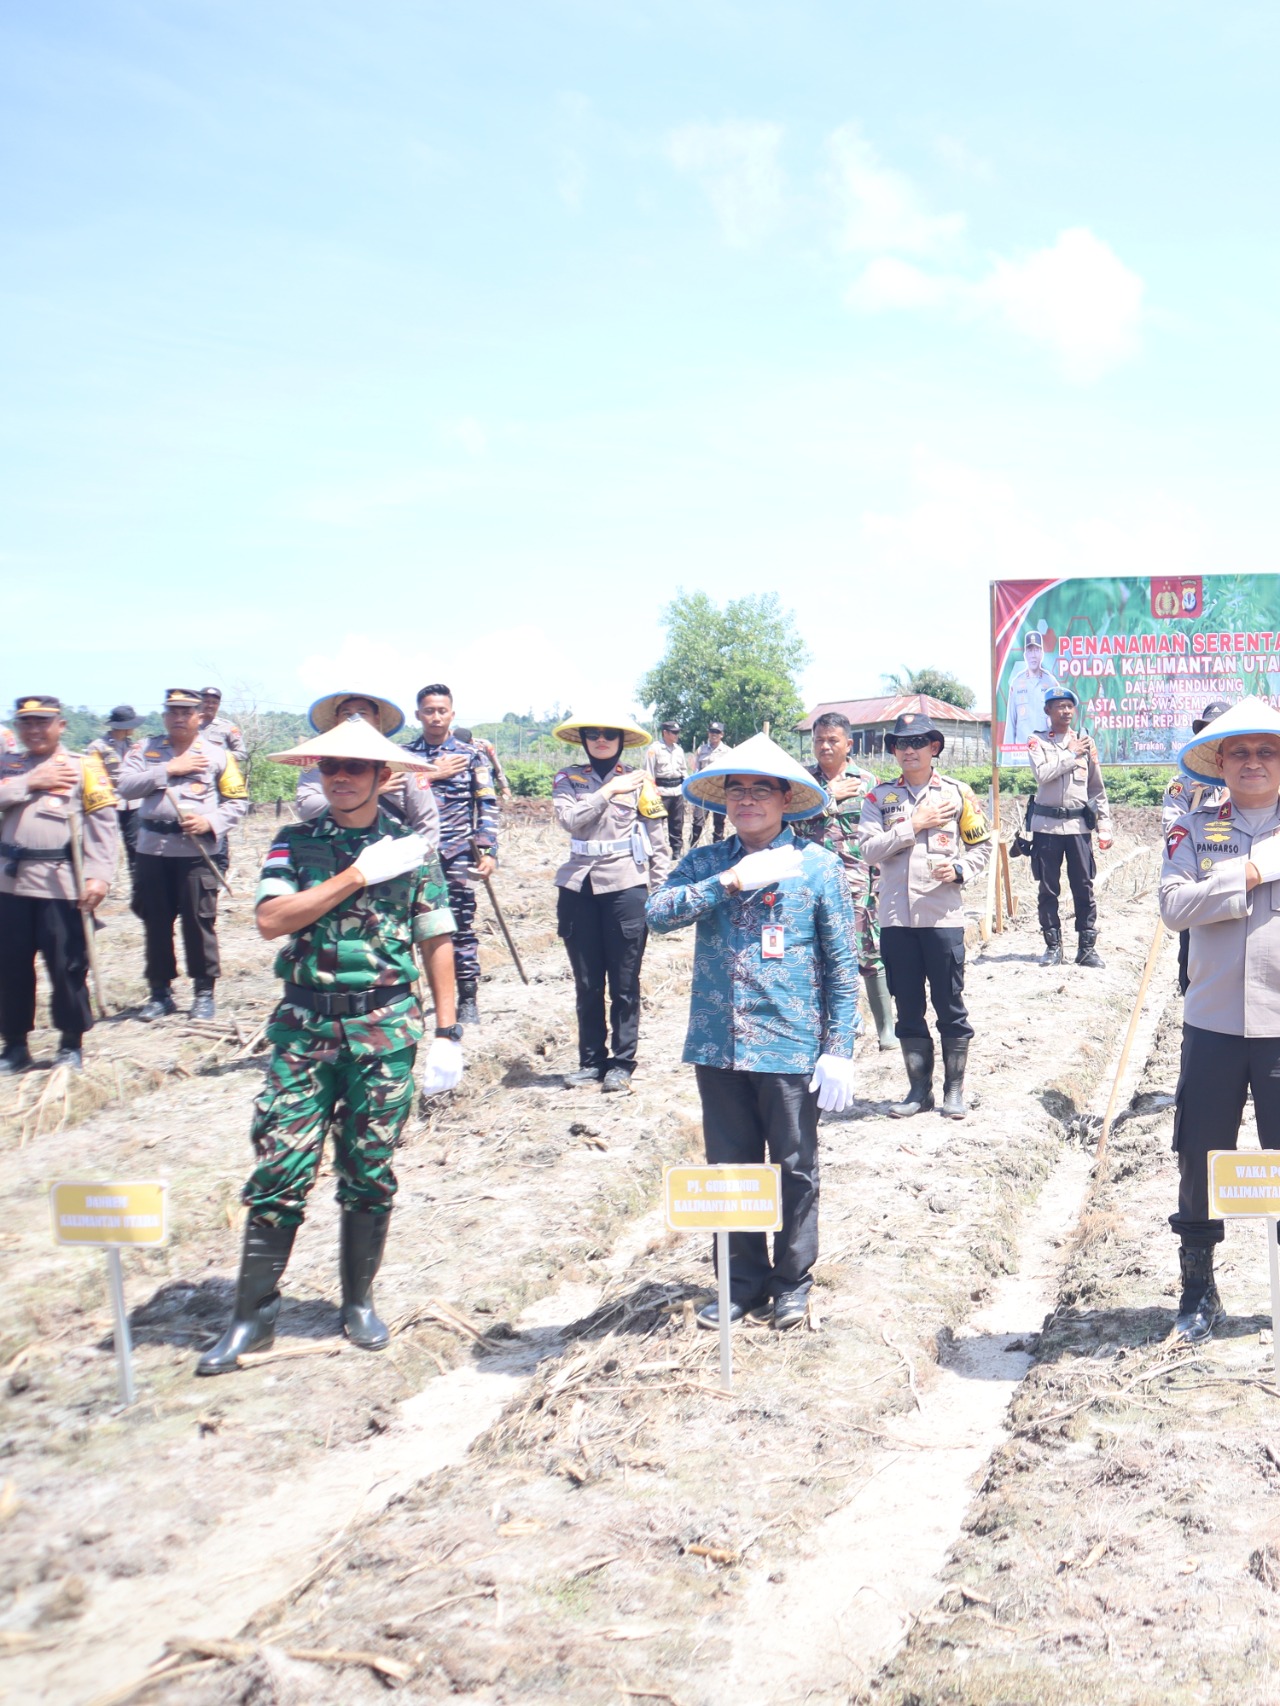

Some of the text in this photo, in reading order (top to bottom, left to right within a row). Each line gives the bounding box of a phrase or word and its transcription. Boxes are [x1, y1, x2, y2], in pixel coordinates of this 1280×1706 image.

[1059, 633, 1186, 656] PENANAMAN
[1058, 658, 1116, 676] POLDA
[1122, 655, 1237, 675] KALIMANTAN
[1125, 678, 1244, 694] DALAM MENDUKUNG
[1087, 698, 1117, 712] ASTA
[1120, 697, 1147, 712] CITA
[1094, 714, 1149, 729] PRESIDEN
[1134, 741, 1166, 751] Tarakan,
[1196, 843, 1239, 854] PANGARSO
[1235, 1165, 1267, 1178] WAKA
[674, 1199, 774, 1212] KALIMANTAN UTARA
